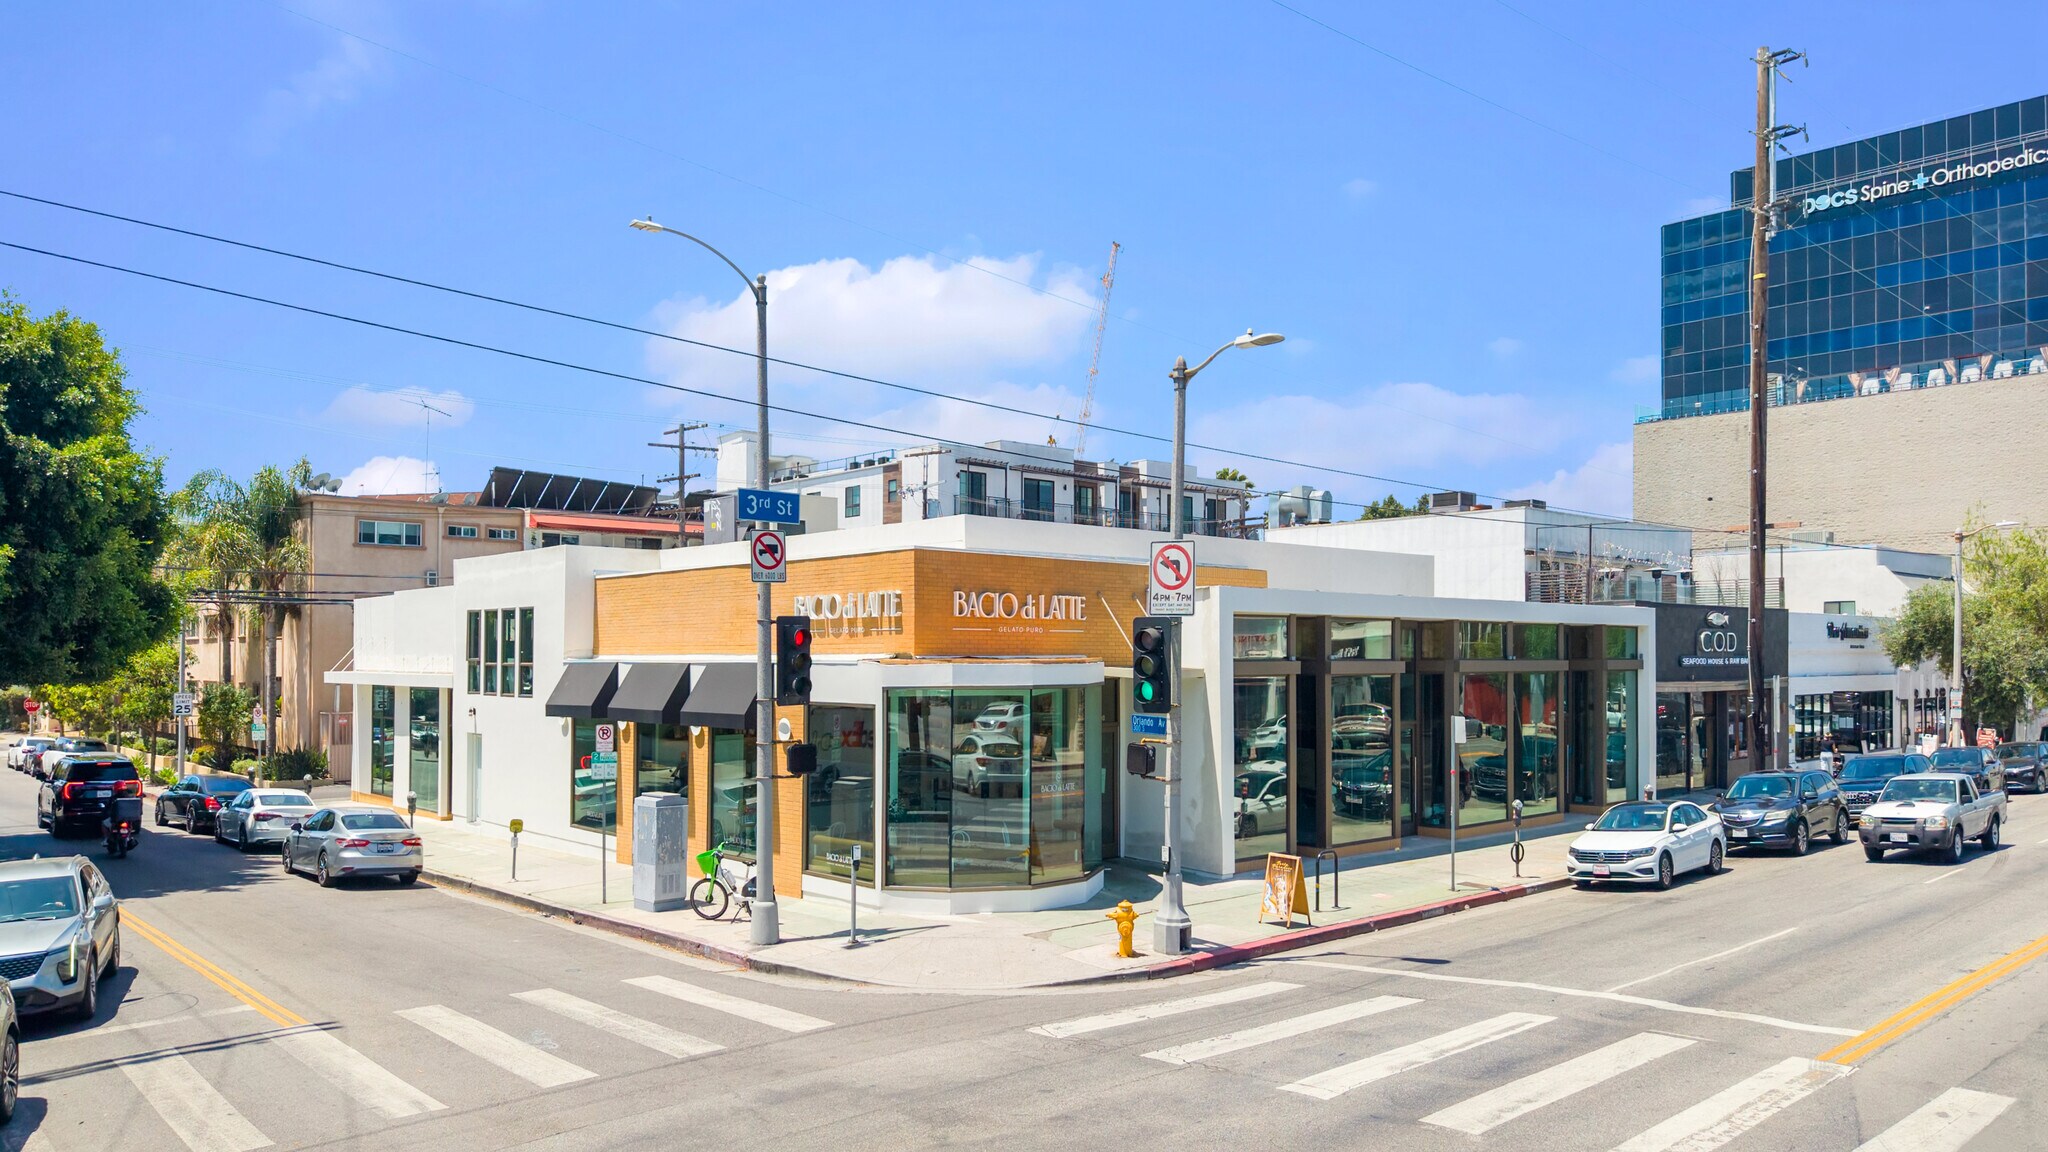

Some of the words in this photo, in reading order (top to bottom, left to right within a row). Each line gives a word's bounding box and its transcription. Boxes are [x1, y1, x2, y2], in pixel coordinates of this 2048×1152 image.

[1860, 179, 1910, 202] Spine
[1931, 149, 2048, 186] Orthopedic
[746, 494, 771, 515] 3rd
[777, 500, 793, 516] St
[794, 593, 842, 620] BACIO
[842, 592, 856, 619] di
[857, 590, 903, 618] LATTE
[953, 590, 1019, 619] BACIO
[1020, 594, 1036, 619] di
[1039, 594, 1087, 621] LATTE
[1700, 631, 1738, 652] C.O.D
[1682, 657, 1707, 665] SEAFOOD
[175, 705, 191, 714] 25
[1132, 715, 1154, 727] Orlando
[1157, 718, 1166, 728] Av
